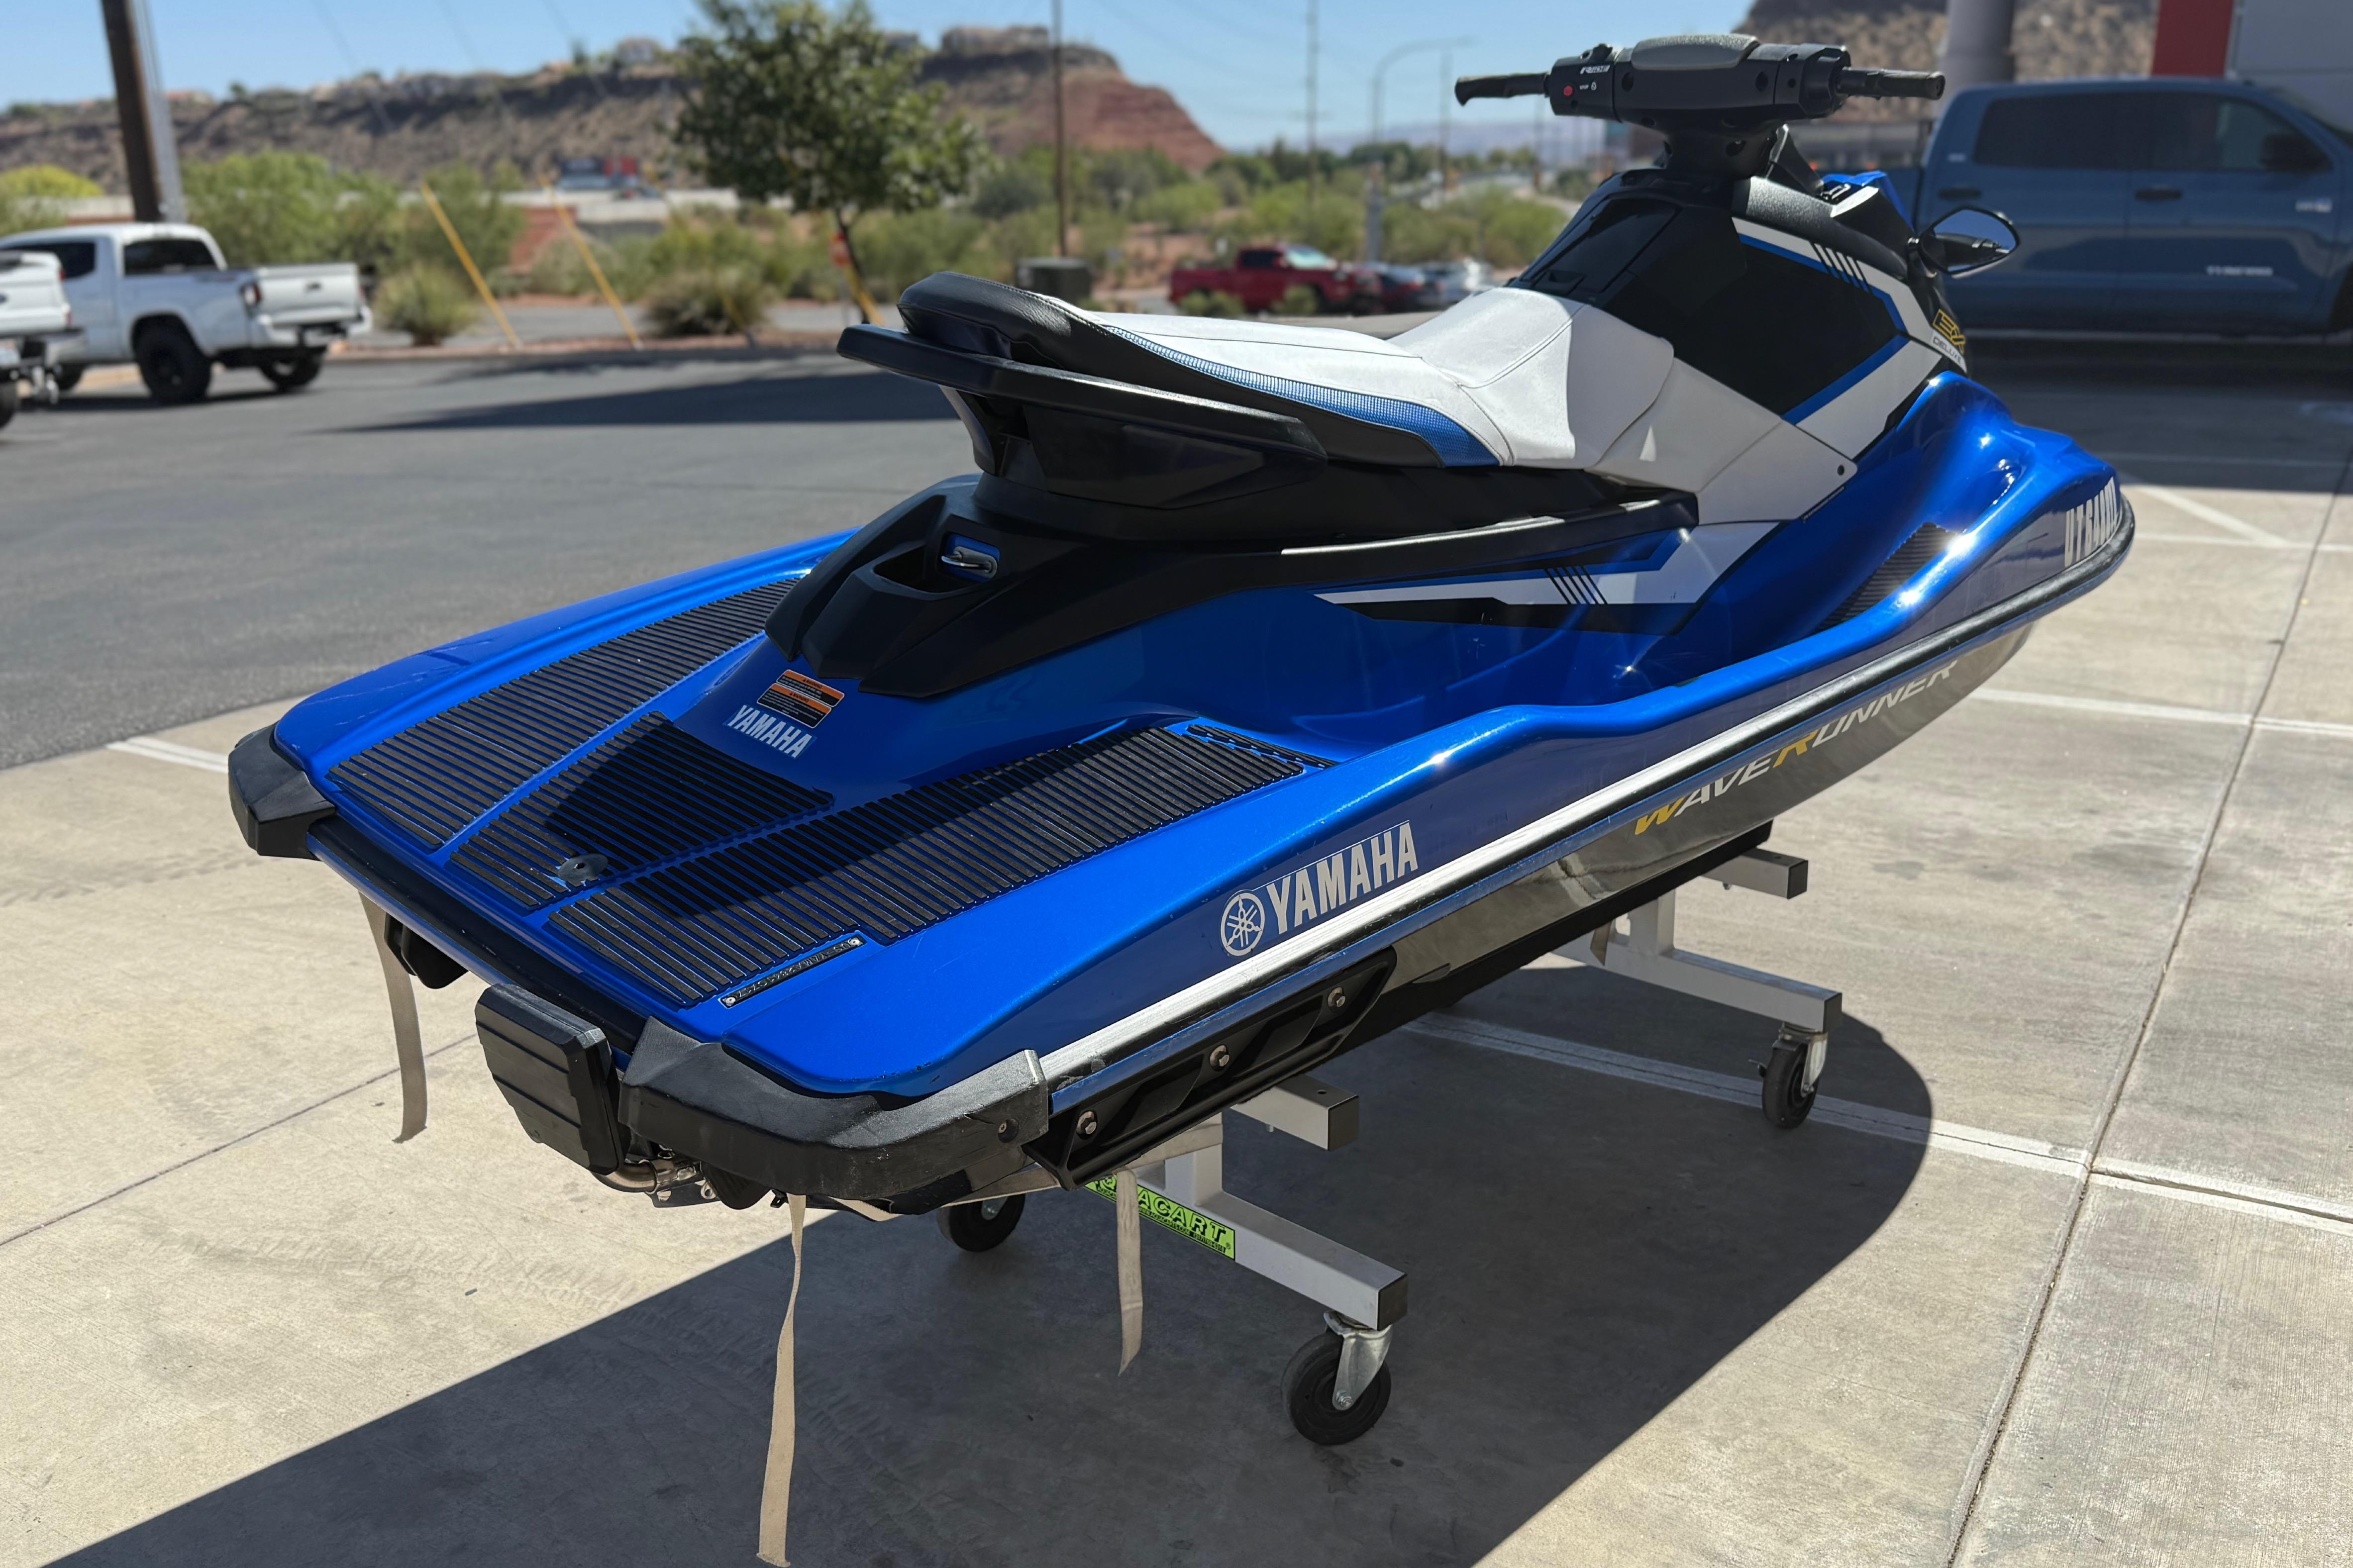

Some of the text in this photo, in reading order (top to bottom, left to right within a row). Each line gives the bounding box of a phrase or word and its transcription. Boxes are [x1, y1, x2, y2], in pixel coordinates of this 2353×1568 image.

[1933, 309, 1965, 355] EX
[1933, 336, 1962, 364] DELUXE
[727, 704, 813, 758] YAMAHA
[1634, 659, 1958, 835] WAVERUNNER
[1266, 823, 1419, 934] YAMAHA
